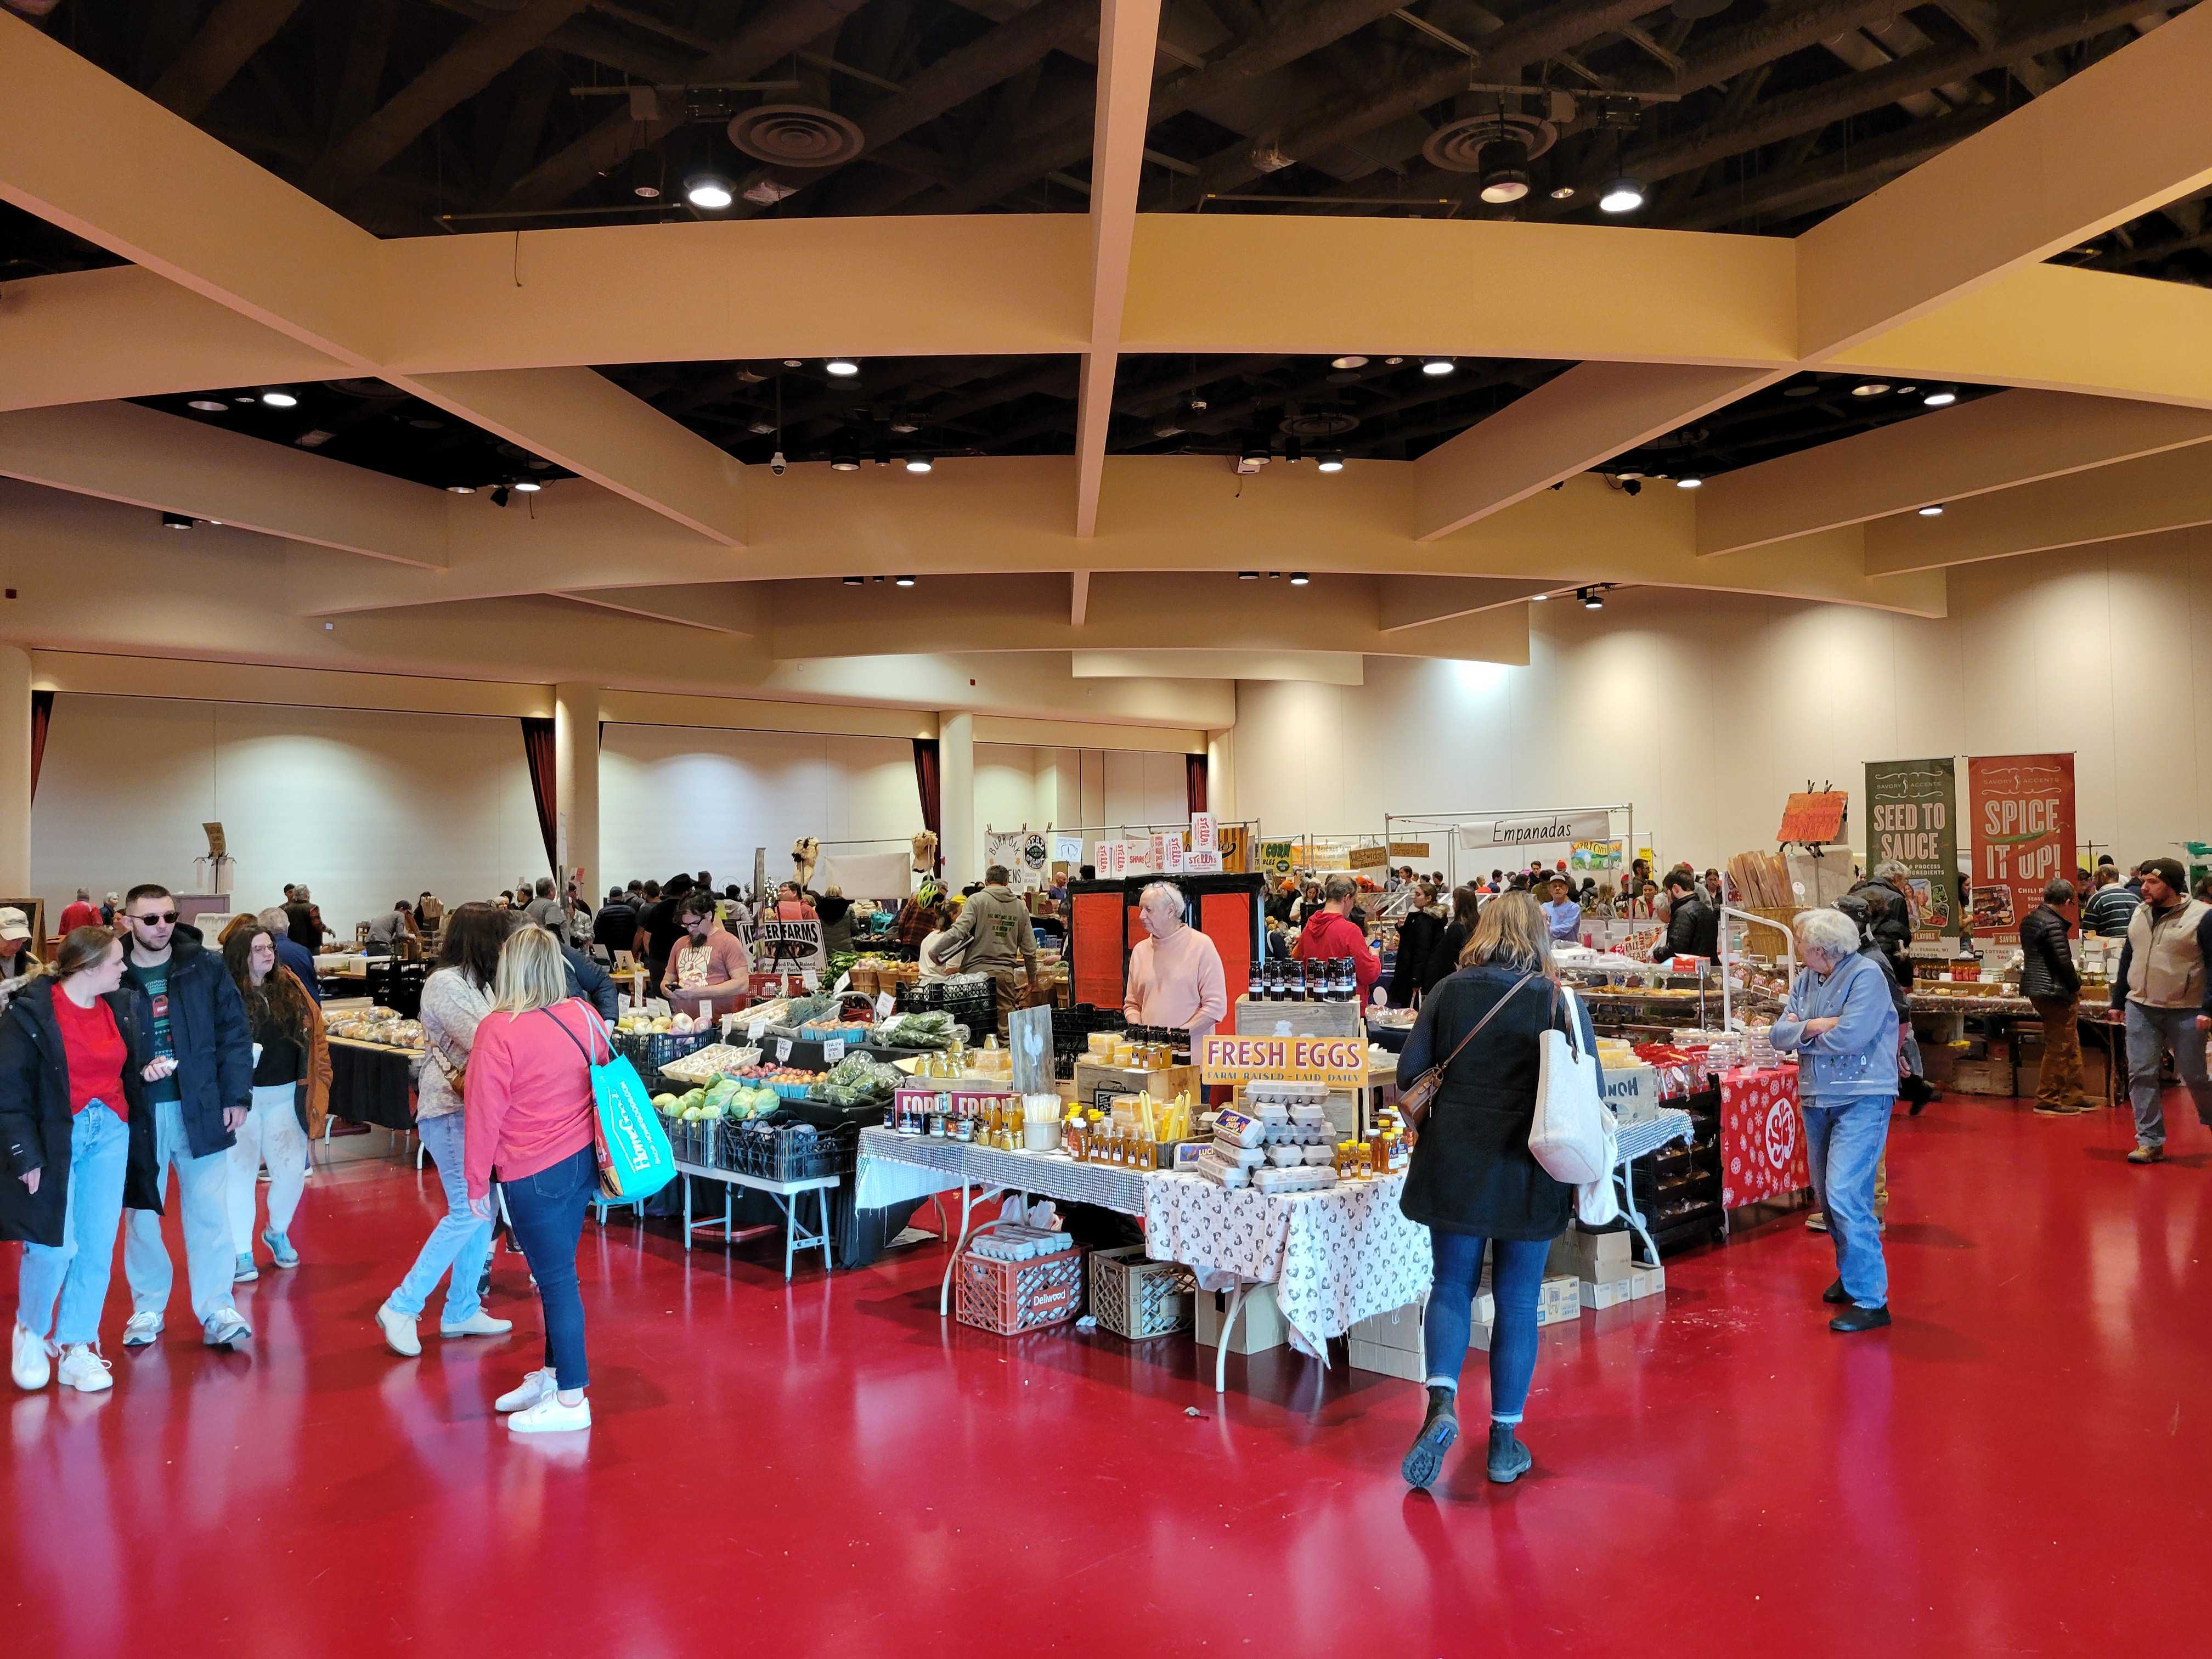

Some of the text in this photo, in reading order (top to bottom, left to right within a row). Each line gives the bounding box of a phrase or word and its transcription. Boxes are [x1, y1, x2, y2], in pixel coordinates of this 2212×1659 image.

[1874, 803, 1945, 831] SEED TO
[1985, 799, 2060, 835] SPICE
[1493, 816, 1571, 845] Empanadas
[989, 834, 1020, 856] BURR OAK
[1266, 843, 1290, 858] CORN
[1572, 842, 1592, 851] CAPRI
[1881, 832, 1939, 860] SAUCE
[1987, 844, 2061, 879] IT UP!
[1008, 868, 1021, 884] ENS
[742, 923, 818, 945] KEER FARMS
[1914, 932, 1935, 940] FLAVORS
[1629, 951, 1646, 961] HAR
[1208, 1041, 1361, 1068] FRESH EGGS
[1207, 1071, 1237, 1080] FARM
[1295, 1073, 1321, 1081] LAID
[650, 1144, 662, 1165] SHOP
[1034, 1289, 1065, 1306] Dellwood
